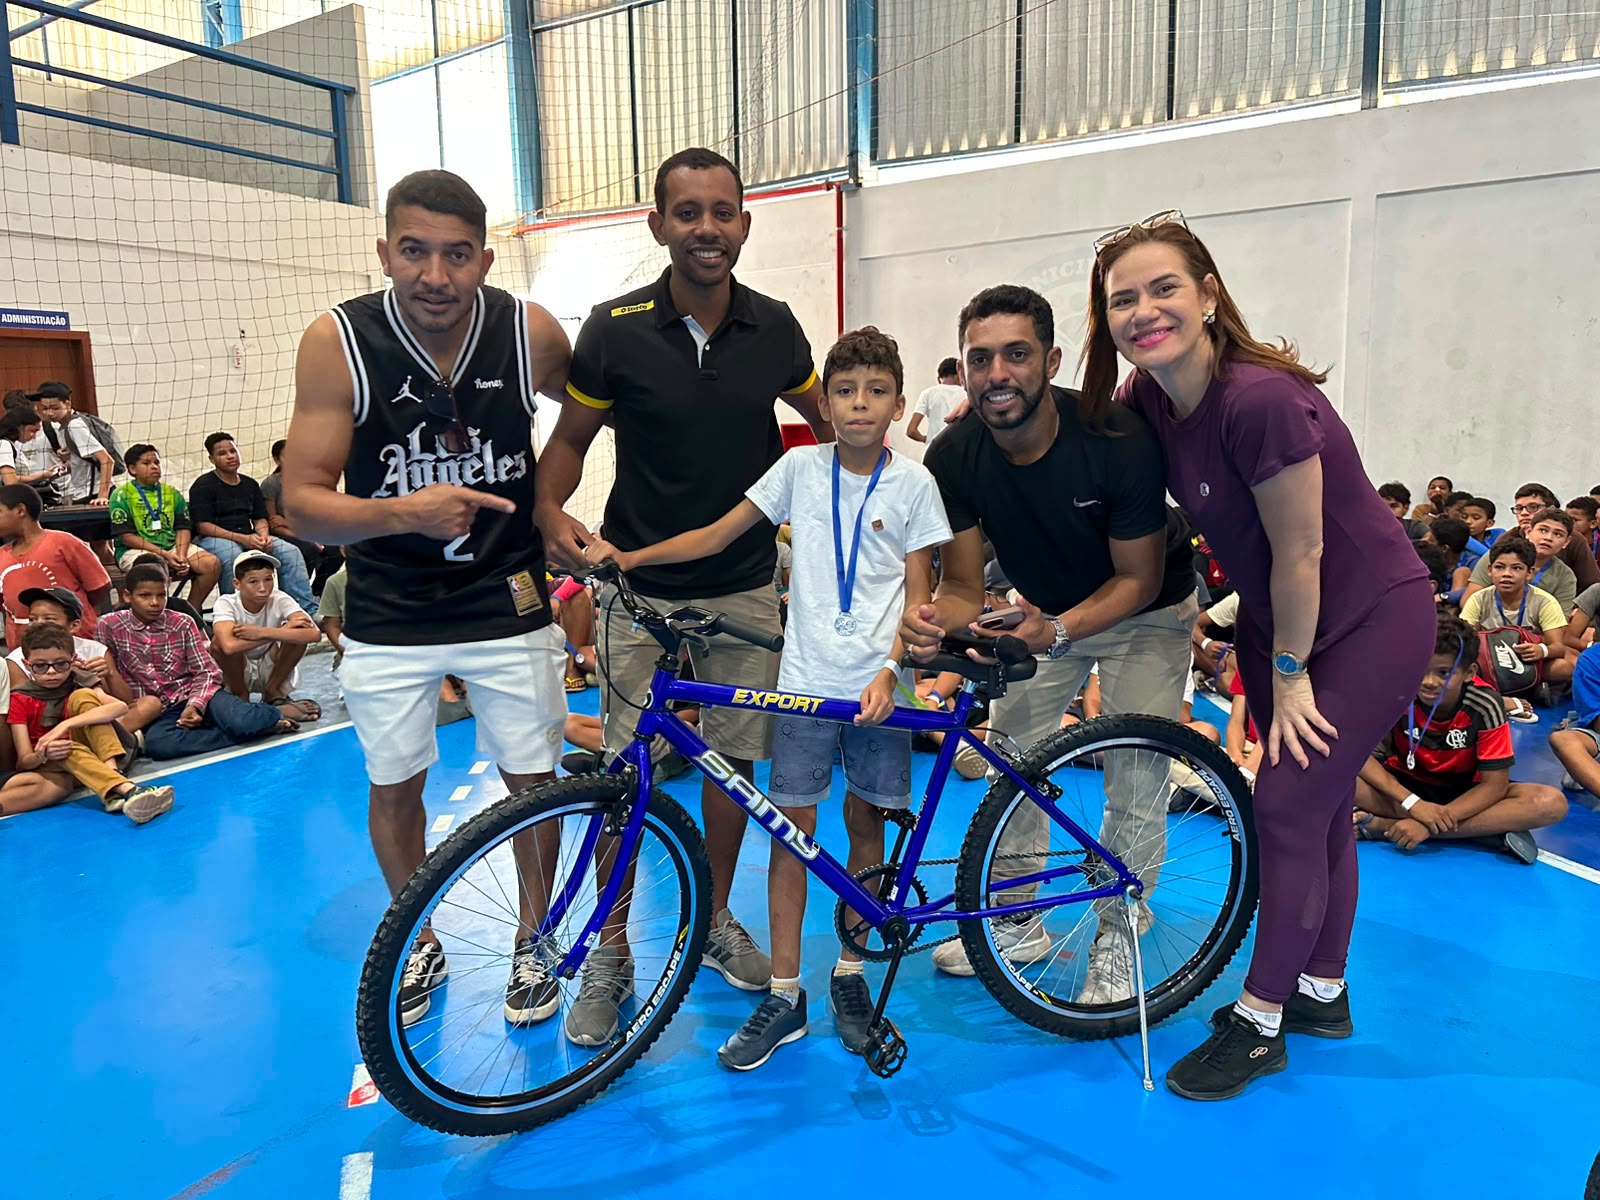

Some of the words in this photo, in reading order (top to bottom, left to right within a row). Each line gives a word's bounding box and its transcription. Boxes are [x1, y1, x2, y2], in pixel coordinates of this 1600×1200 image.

[1, 313, 67, 326] ADMINISTRAÇÃO
[371, 439, 527, 499] Angeles
[1494, 645, 1515, 669] NIKE
[732, 687, 826, 714] EXPORT
[1197, 768, 1231, 808] ESCAPE
[1225, 809, 1241, 842] AERO
[1000, 951, 1034, 991] ESCAPE
[625, 1005, 654, 1042] AERO
[651, 950, 682, 1007] ESCAPE
